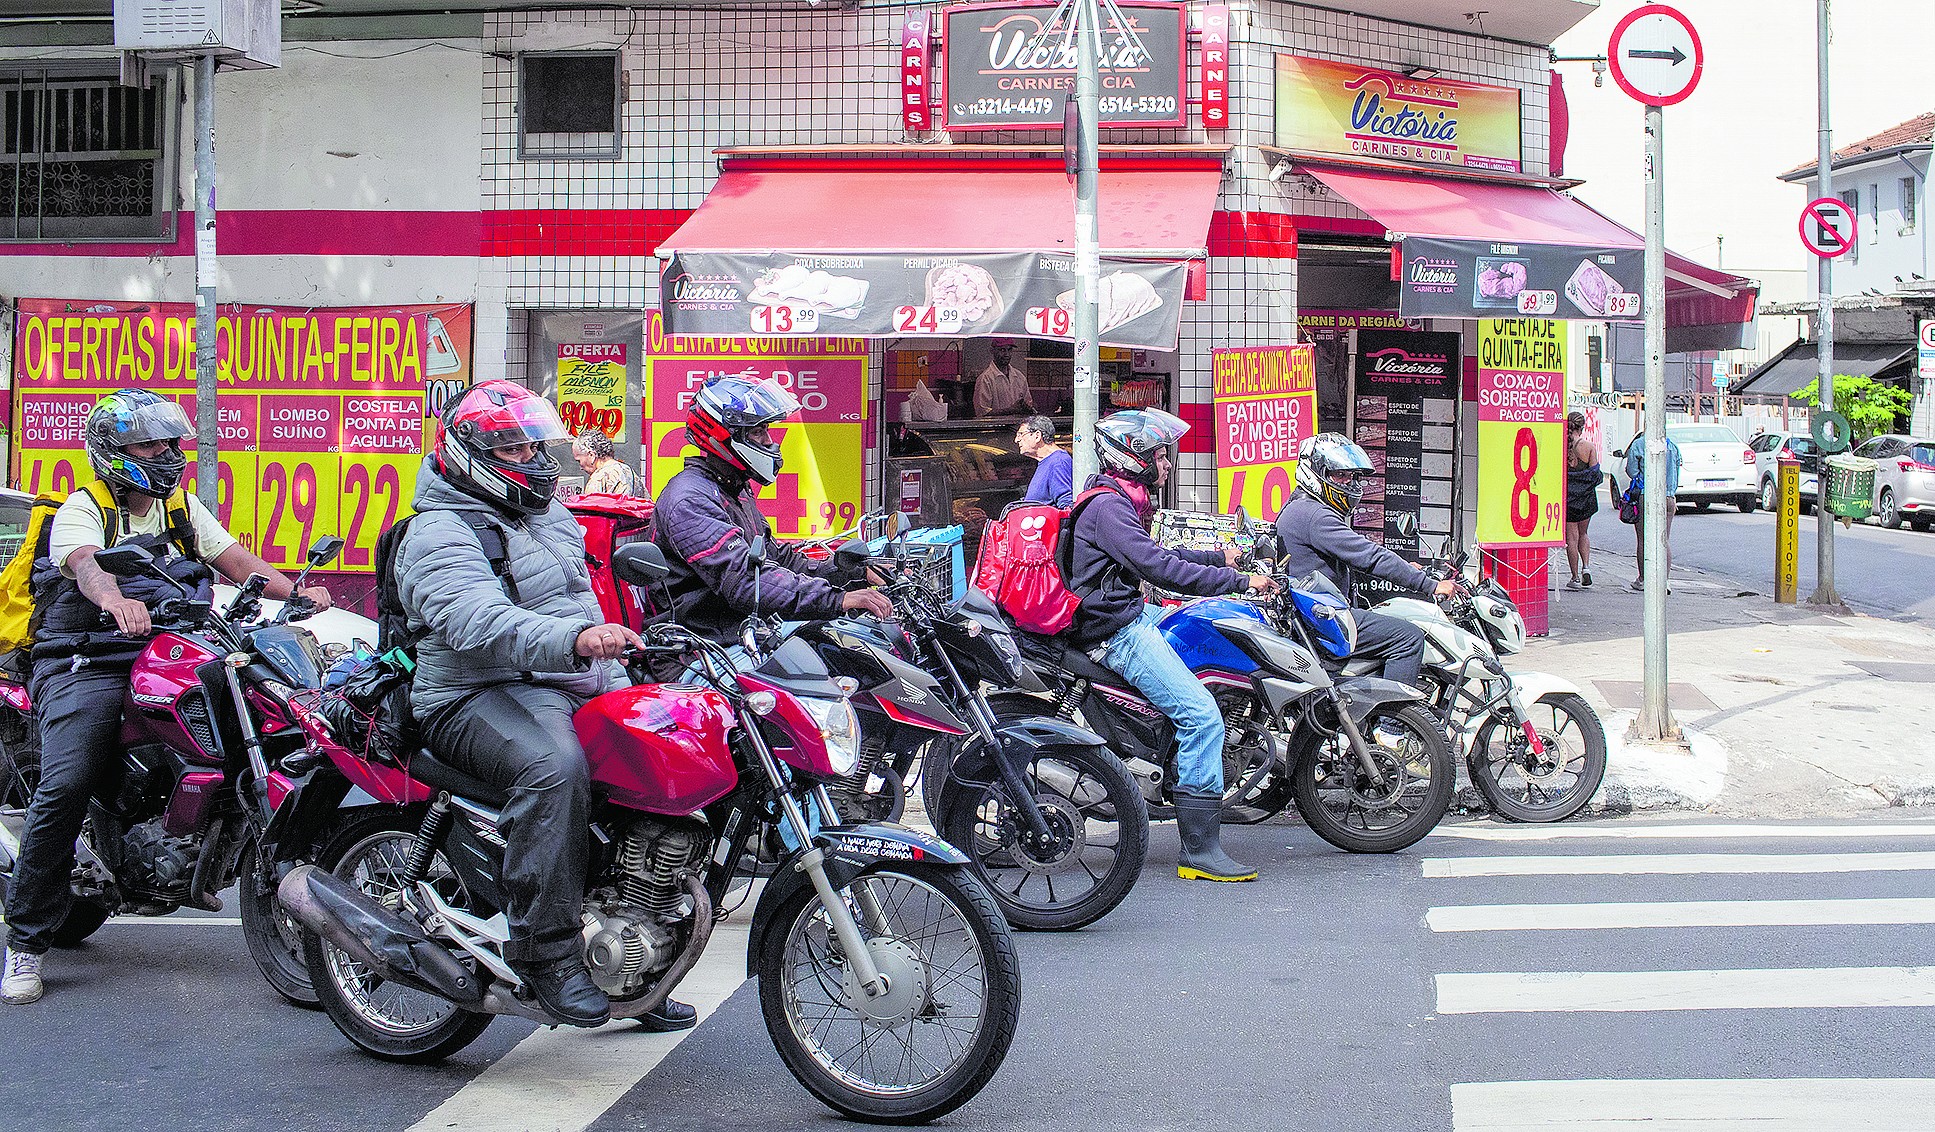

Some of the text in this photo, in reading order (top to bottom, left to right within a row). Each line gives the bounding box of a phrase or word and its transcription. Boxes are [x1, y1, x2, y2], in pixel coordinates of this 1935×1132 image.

[989, 29, 1146, 70] Victia
[904, 20, 923, 124] CARNES
[1206, 14, 1225, 120] CARNES
[998, 76, 1136, 91] CARNES CIA
[978, 98, 1053, 115] 3214-4479
[1098, 96, 1176, 114] 6514-5320
[1351, 90, 1457, 141] Victória
[1352, 141, 1452, 161] CARNES & CIA
[794, 259, 813, 268] COXA
[821, 259, 864, 269] SOBRECOXA
[903, 259, 958, 268] PERNIL PICADO
[1040, 258, 1070, 271] BISTECA
[1411, 263, 1457, 284] Victória
[674, 281, 739, 300] Victória
[678, 303, 707, 311] CARNES
[721, 303, 735, 311] CIA
[1298, 314, 1406, 328] CARNE DA REGIÃO
[25, 316, 422, 386] OFERTAS DE QUINTA-FEIRA
[563, 345, 621, 355] OFERTA
[1214, 348, 1314, 395] OFERTA DE QUINTA-FEIRA
[1374, 357, 1444, 374] Victória
[772, 371, 818, 389] DE
[1371, 376, 1412, 384] CARNES
[1493, 373, 1533, 388] COXA
[24, 402, 91, 415] PATINHO
[348, 400, 419, 413] COSTELA
[1227, 399, 1300, 423] PATINHO
[26, 415, 87, 428] P/ MOER
[270, 408, 330, 422] LOMBO
[272, 424, 326, 439] SUÍNO
[345, 418, 421, 431] PONTA DE
[1229, 419, 1298, 443] P/ MOER
[26, 429, 86, 441] OU BIFE
[350, 435, 414, 449] AGULHA
[1229, 439, 1297, 463] OU BIFE
[261, 462, 317, 564] 29
[343, 463, 401, 565] 22
[1786, 476, 1794, 593] 08000110197
[134, 694, 174, 703] FAZER
[897, 696, 926, 705] HONDA
[1103, 693, 1163, 718] TITAN
[182, 784, 202, 793] YAMAHA
